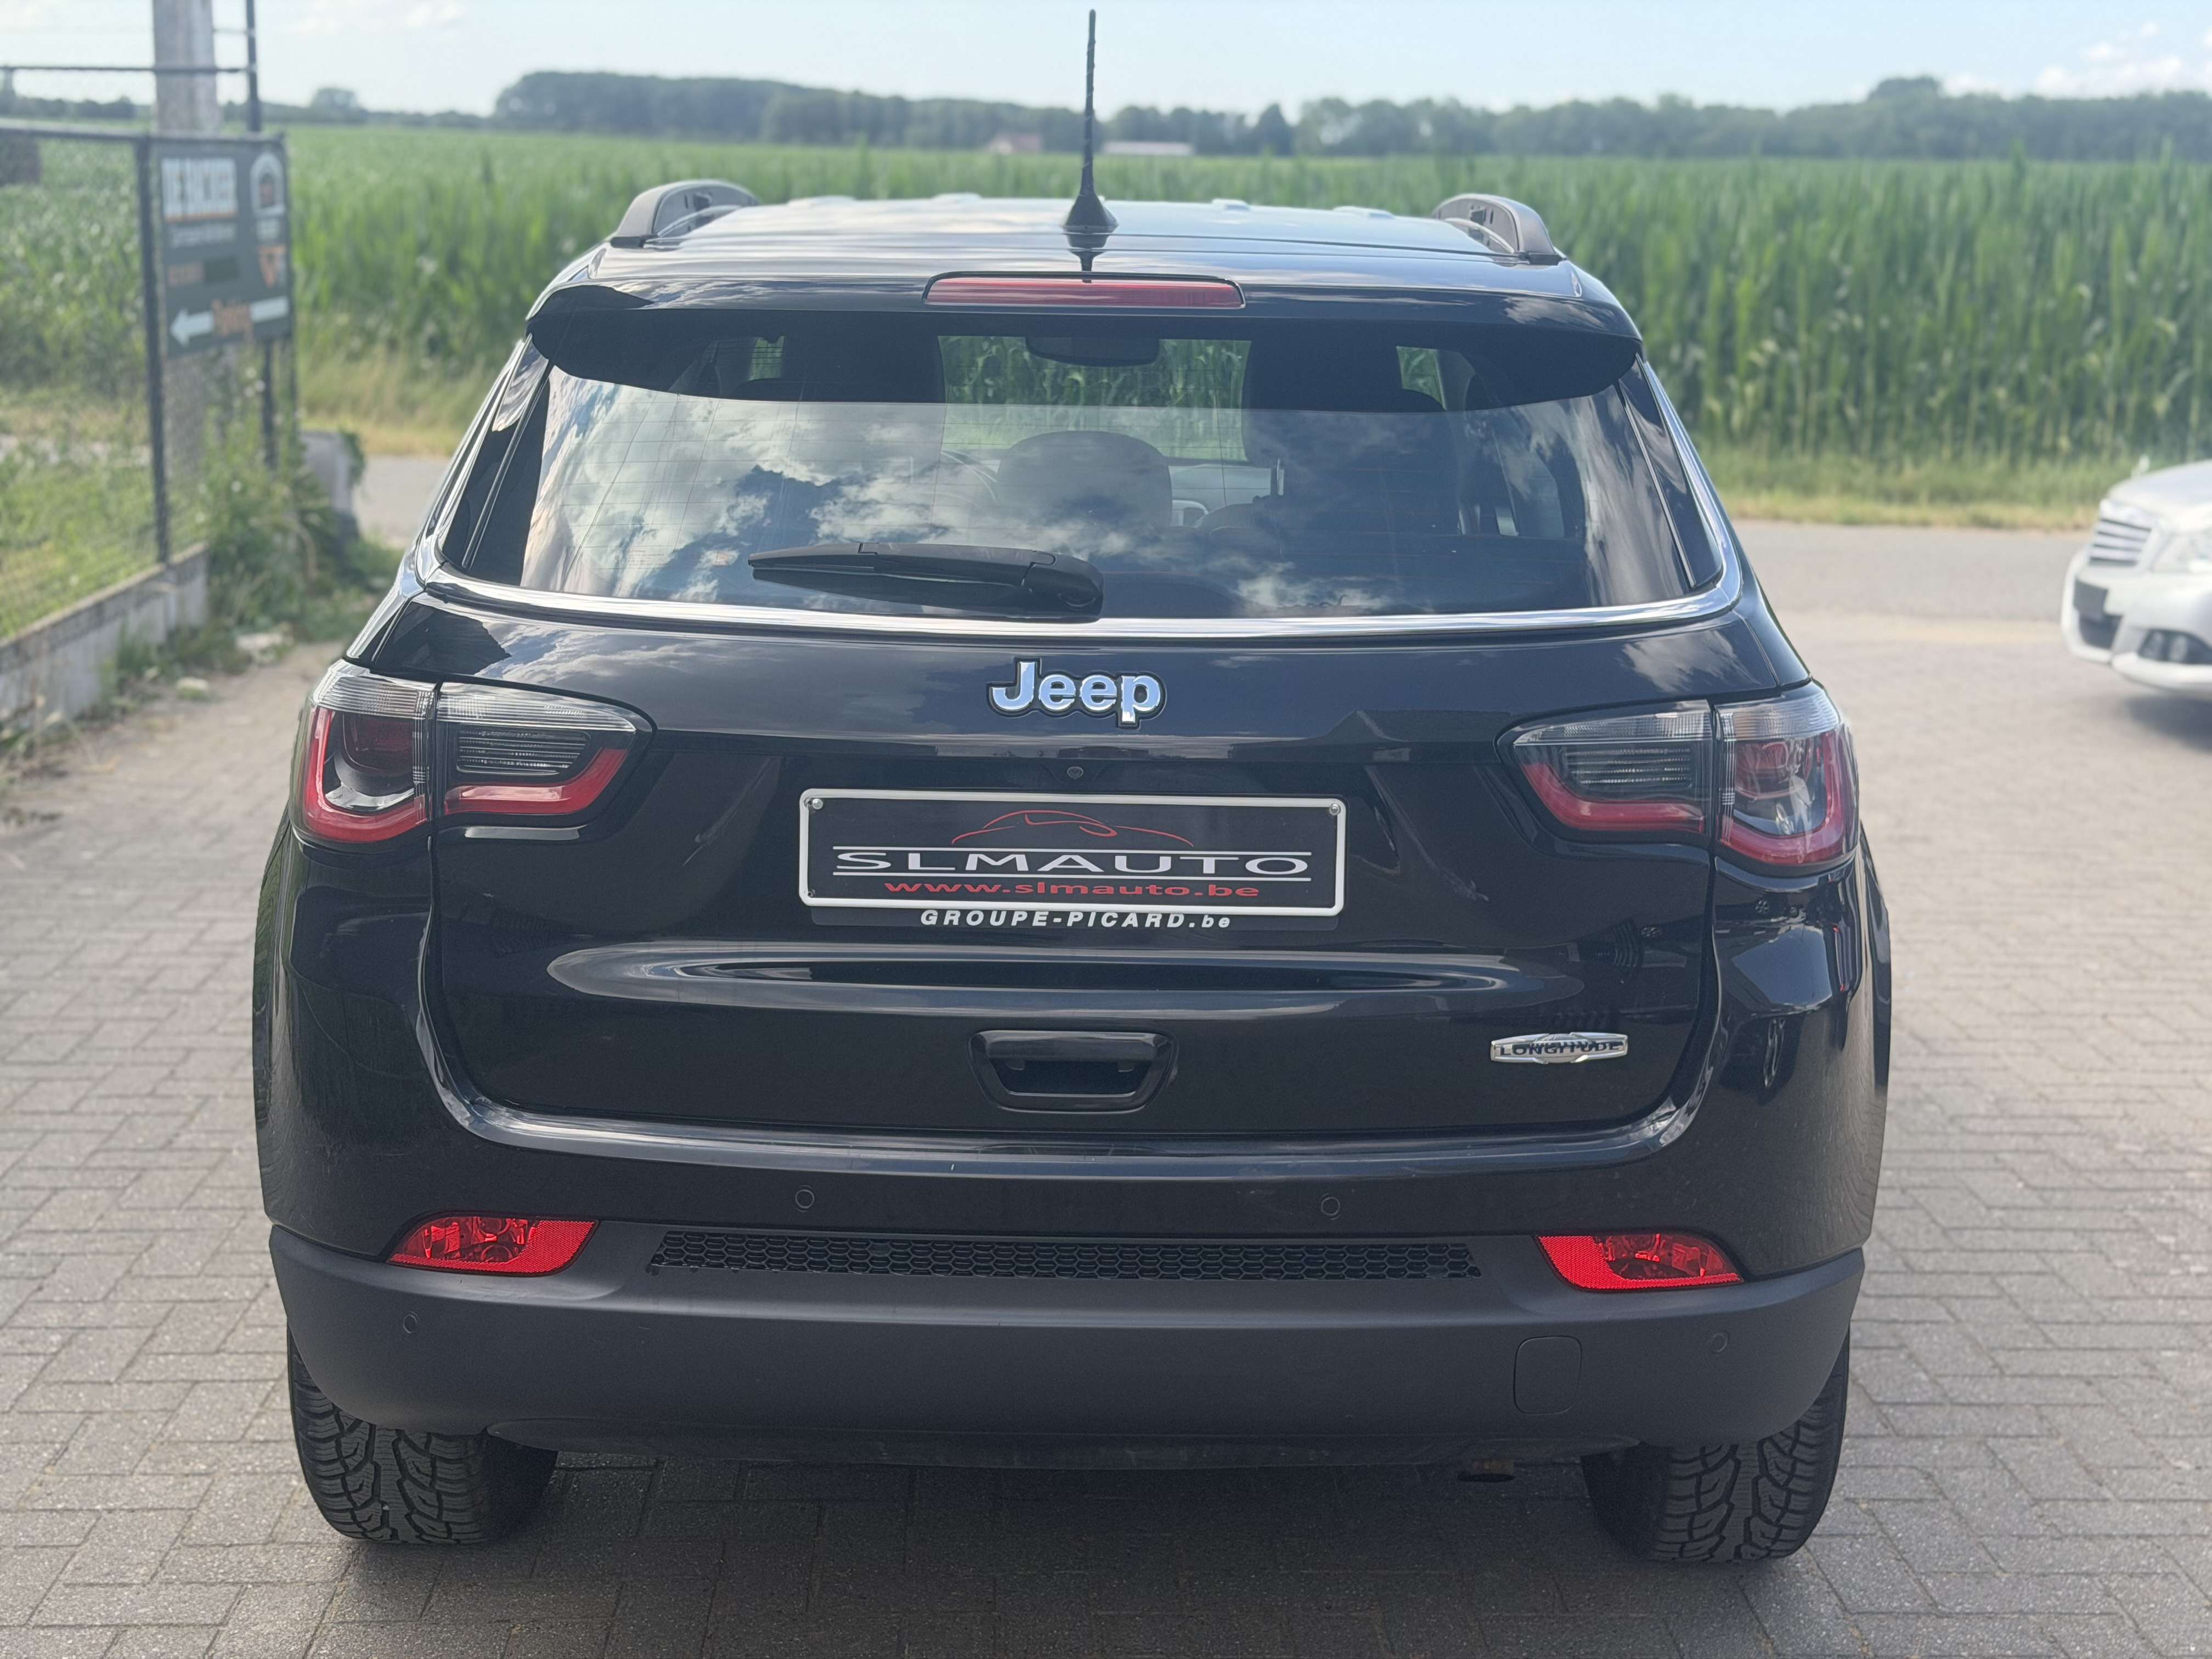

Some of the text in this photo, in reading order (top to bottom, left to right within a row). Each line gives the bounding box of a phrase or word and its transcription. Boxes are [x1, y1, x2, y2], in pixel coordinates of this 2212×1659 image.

[989, 658, 1163, 726] Jeep
[837, 852, 1308, 875] SLMAUTO
[885, 882, 1259, 896] www.slmauto.be
[921, 910, 1231, 928] GROUPE-PICARD.be
[1499, 1040, 1624, 1056] LONGITUDE
